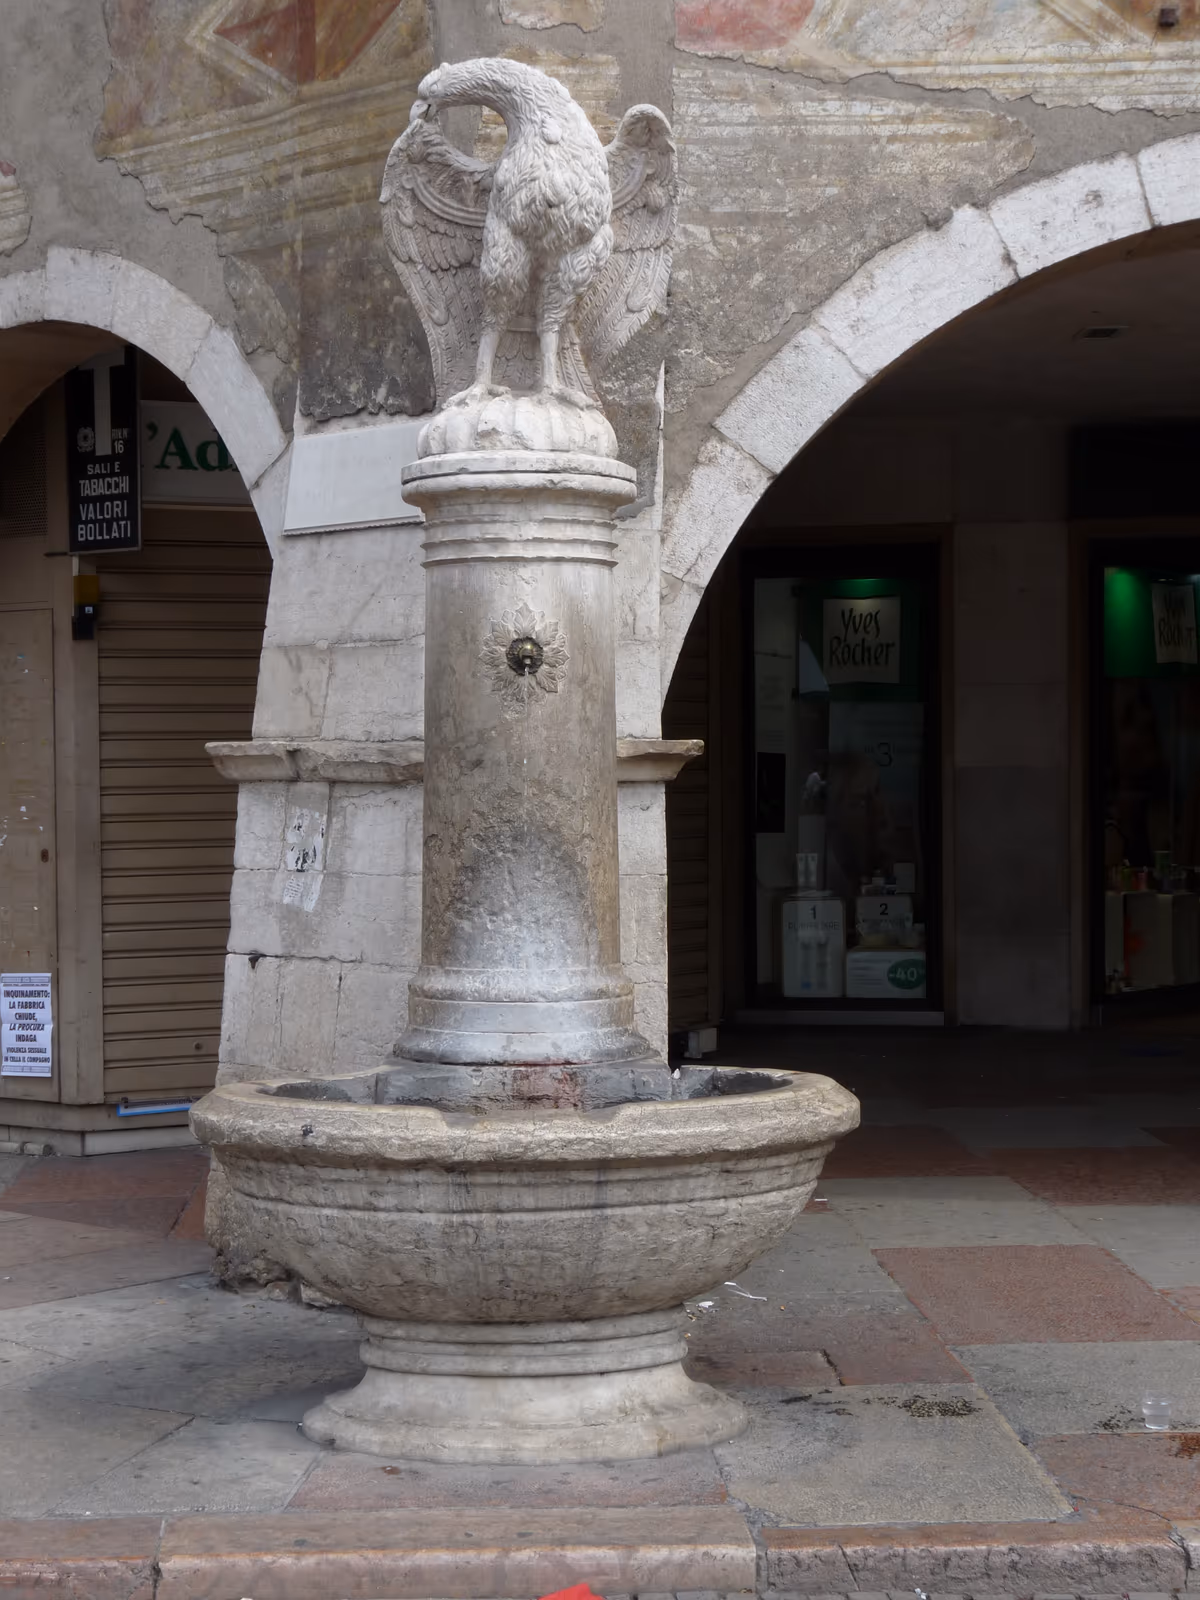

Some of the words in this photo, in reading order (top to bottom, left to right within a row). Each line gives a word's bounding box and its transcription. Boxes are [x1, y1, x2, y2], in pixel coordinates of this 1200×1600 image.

[114, 440, 124, 454] 16
[87, 462, 111, 475] SALI
[114, 461, 121, 473] E
[79, 476, 129, 497] TABACCHI
[79, 500, 127, 521] VALORI
[77, 520, 131, 541] BOLLATI
[841, 607, 881, 641] Yves
[829, 636, 895, 668] Rocher
[879, 903, 889, 916] 2
[889, 967, 921, 982] -40
[4, 990, 50, 999] INQUINAMENTO:
[9, 1001, 16, 1009] LA
[17, 1001, 45, 1009] FABBRICA
[15, 1012, 38, 1022] CHIUDE,
[9, 1023, 16, 1031] LA
[17, 1023, 45, 1031] PROCURA
[15, 1034, 37, 1042] INDAGA
